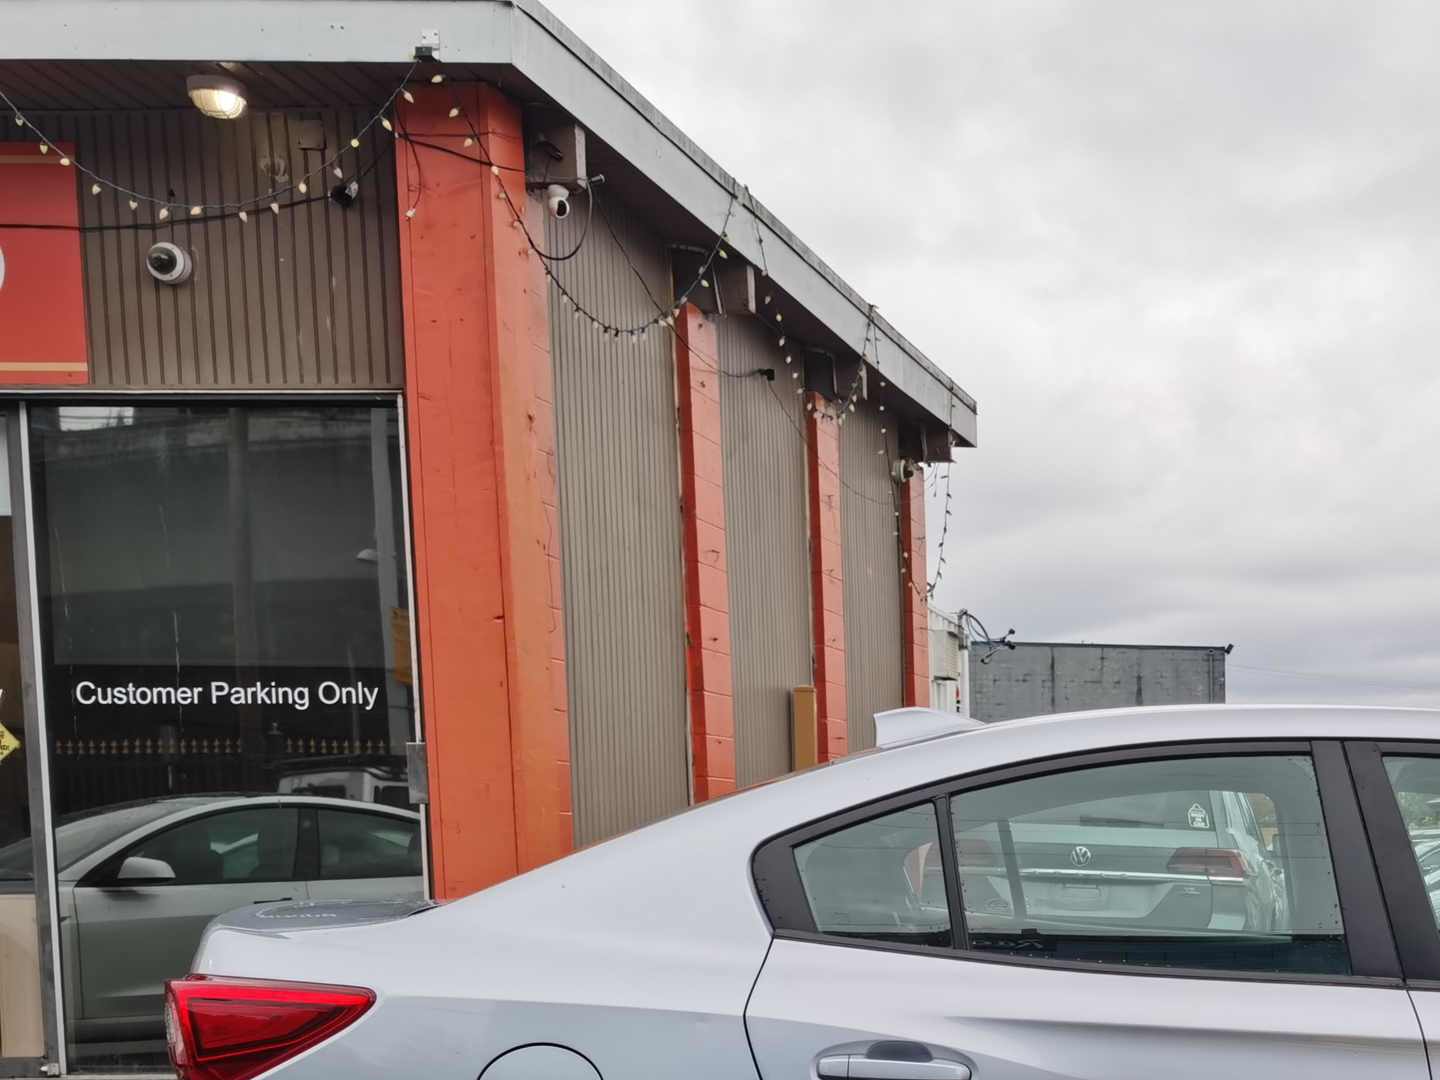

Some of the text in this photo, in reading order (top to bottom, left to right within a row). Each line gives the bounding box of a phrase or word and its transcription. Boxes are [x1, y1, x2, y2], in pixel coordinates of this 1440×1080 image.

[75, 681, 379, 711] Customer Parking Only
